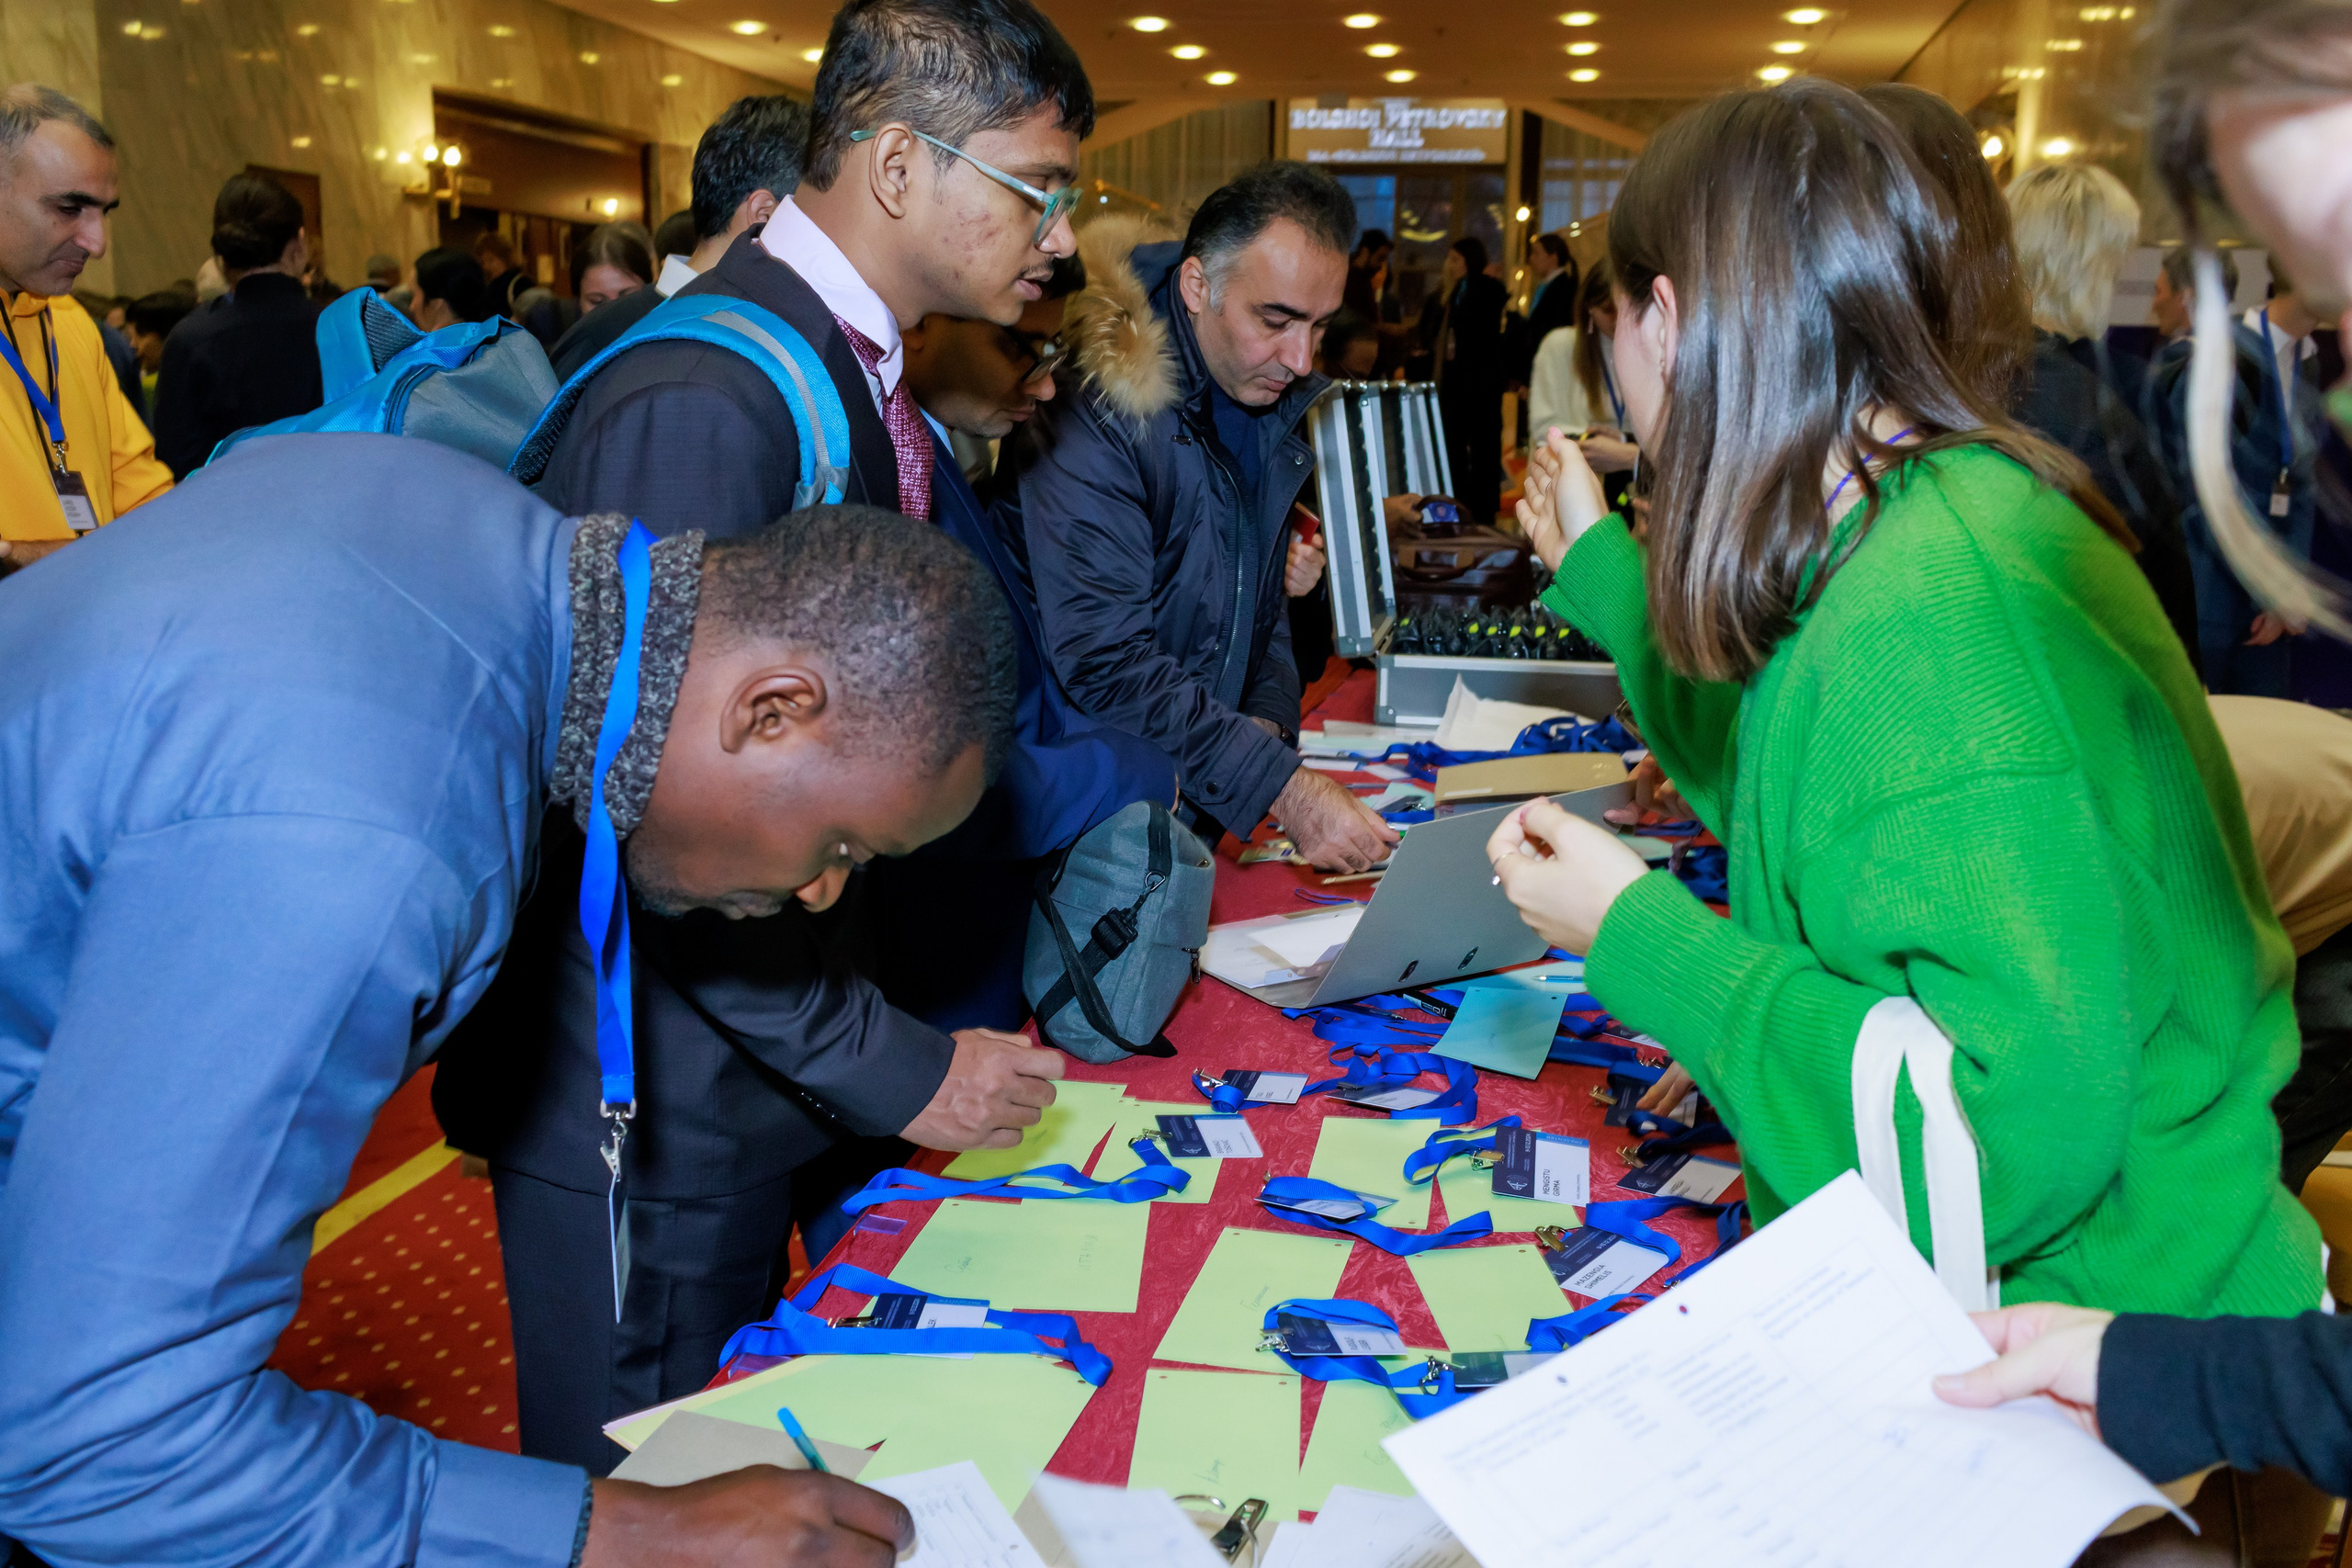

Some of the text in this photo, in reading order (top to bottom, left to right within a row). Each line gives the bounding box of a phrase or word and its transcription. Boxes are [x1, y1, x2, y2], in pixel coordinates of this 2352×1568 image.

[1543, 1168, 1551, 1195] MENGISTU
[1574, 1263, 1606, 1287] MAZENGIA
[1584, 1269, 1612, 1290] SHIMELIS
